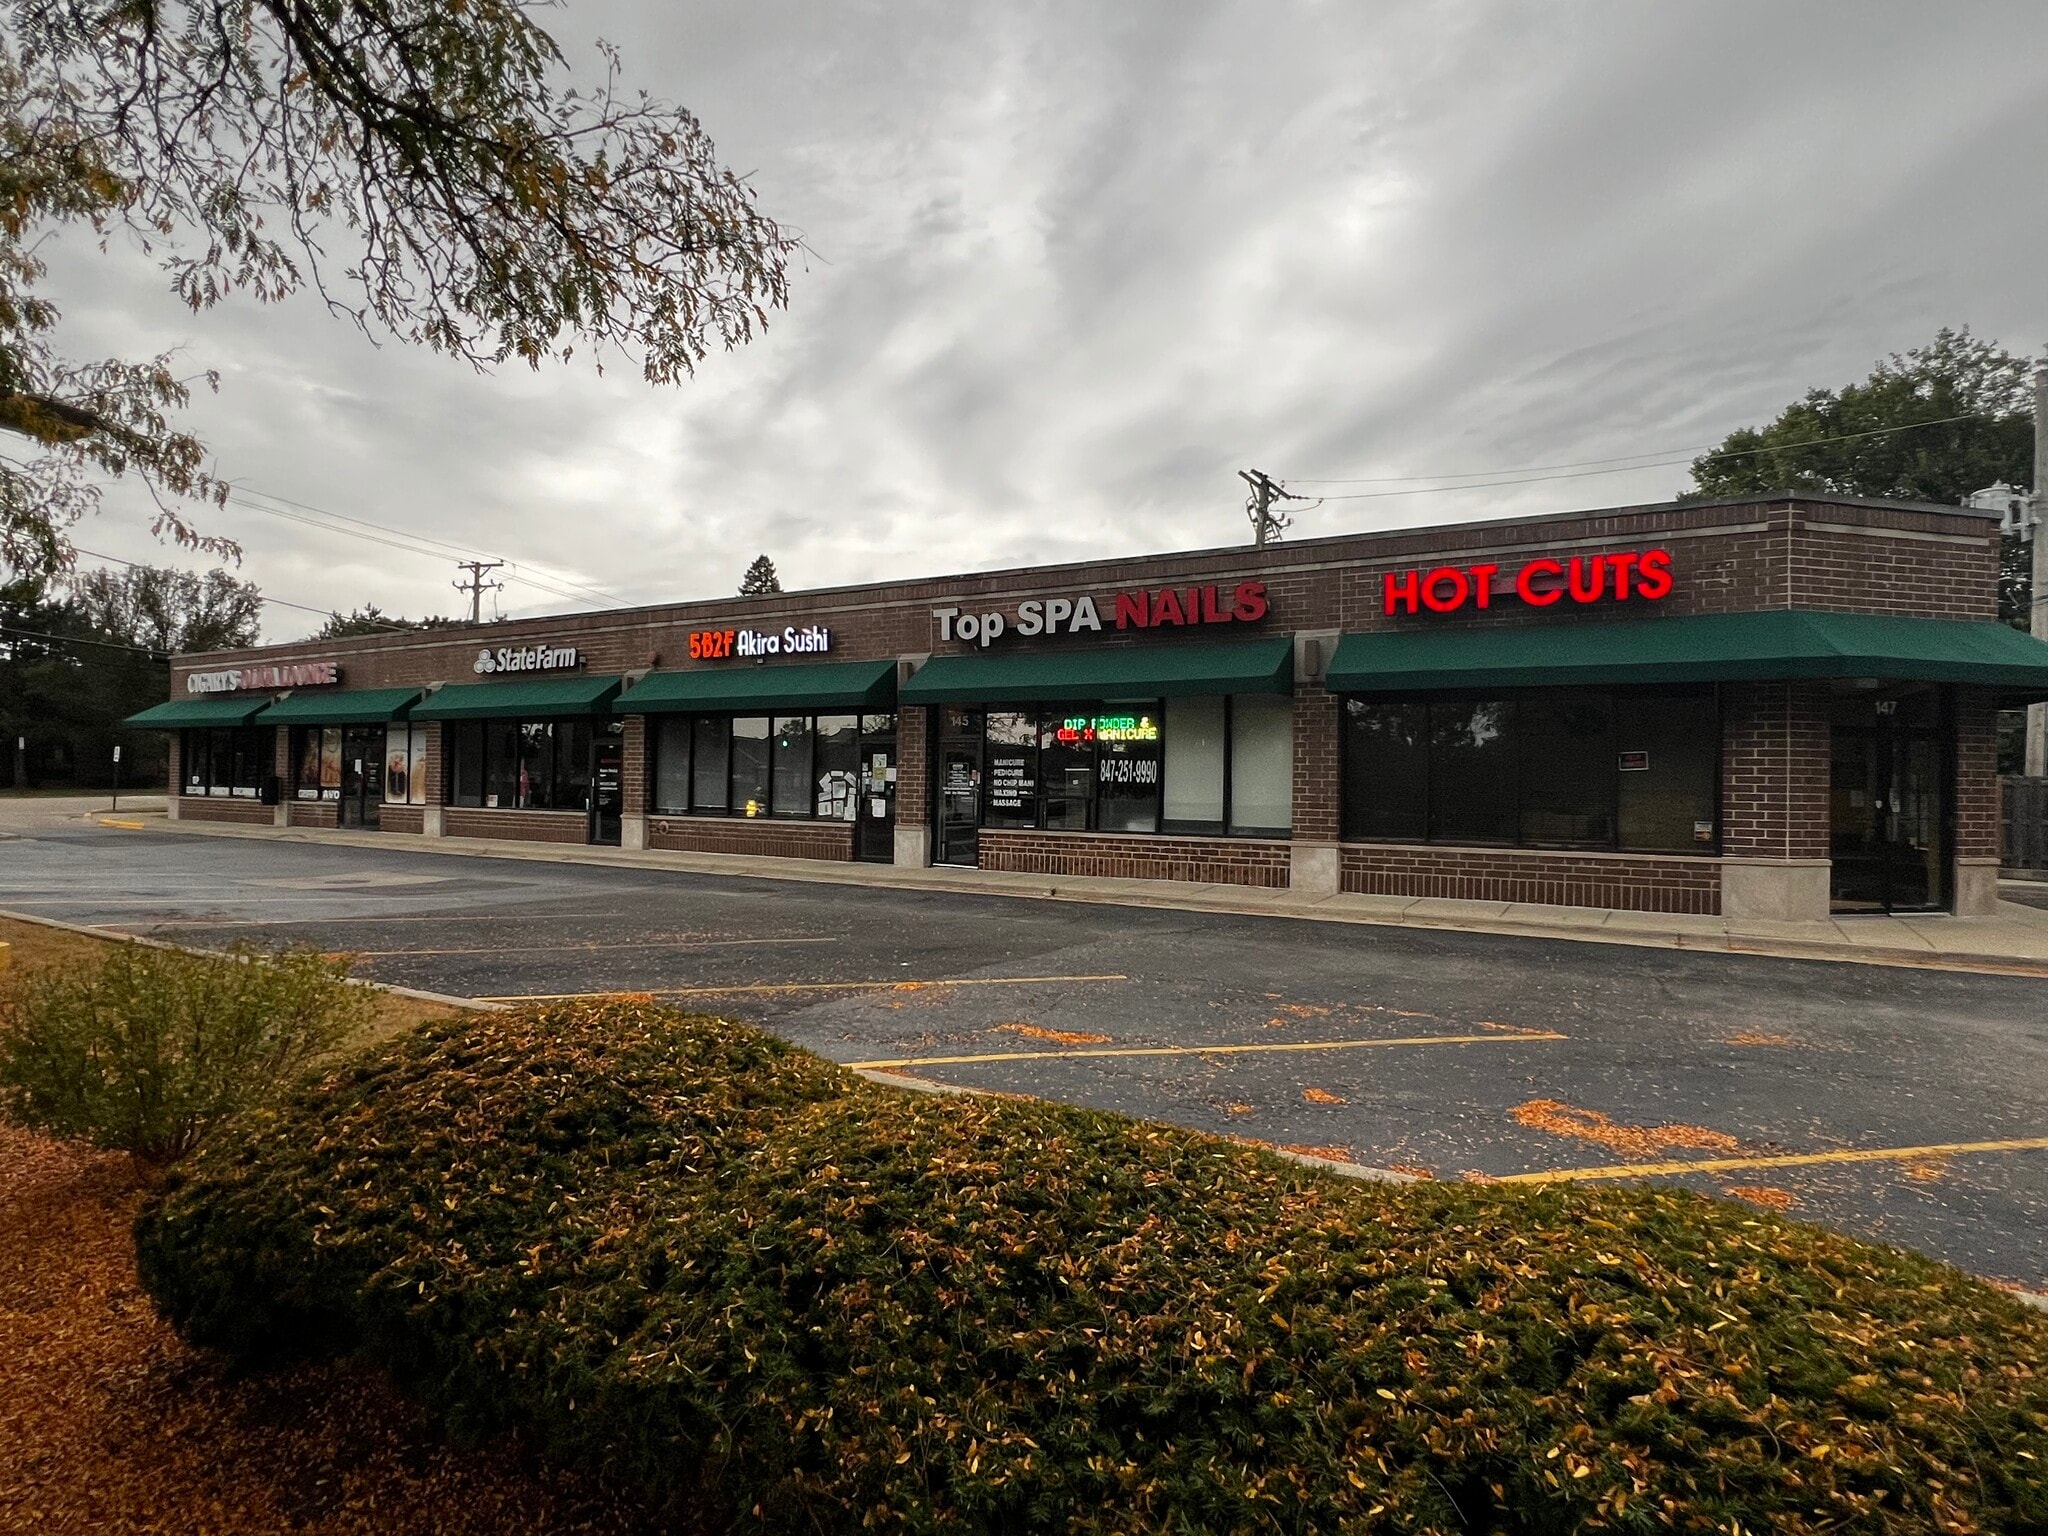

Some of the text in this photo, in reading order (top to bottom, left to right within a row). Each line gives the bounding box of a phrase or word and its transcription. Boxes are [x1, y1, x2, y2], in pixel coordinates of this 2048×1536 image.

[1384, 549, 1674, 616] HOT CUTS
[933, 581, 1268, 647] Top SPA NAILS
[737, 630, 781, 656] Akira
[784, 625, 829, 653] Sushi
[1875, 701, 1898, 715] 147
[951, 715, 969, 727] 145
[1064, 718, 1086, 730] DIP
[1140, 716, 1150, 728] &
[1057, 727, 1156, 740] GEL X MANICURE
[1100, 759, 1157, 784] 847-251-9990
[993, 789, 1017, 797] WAXING
[993, 799, 1022, 807] MASSAGE
